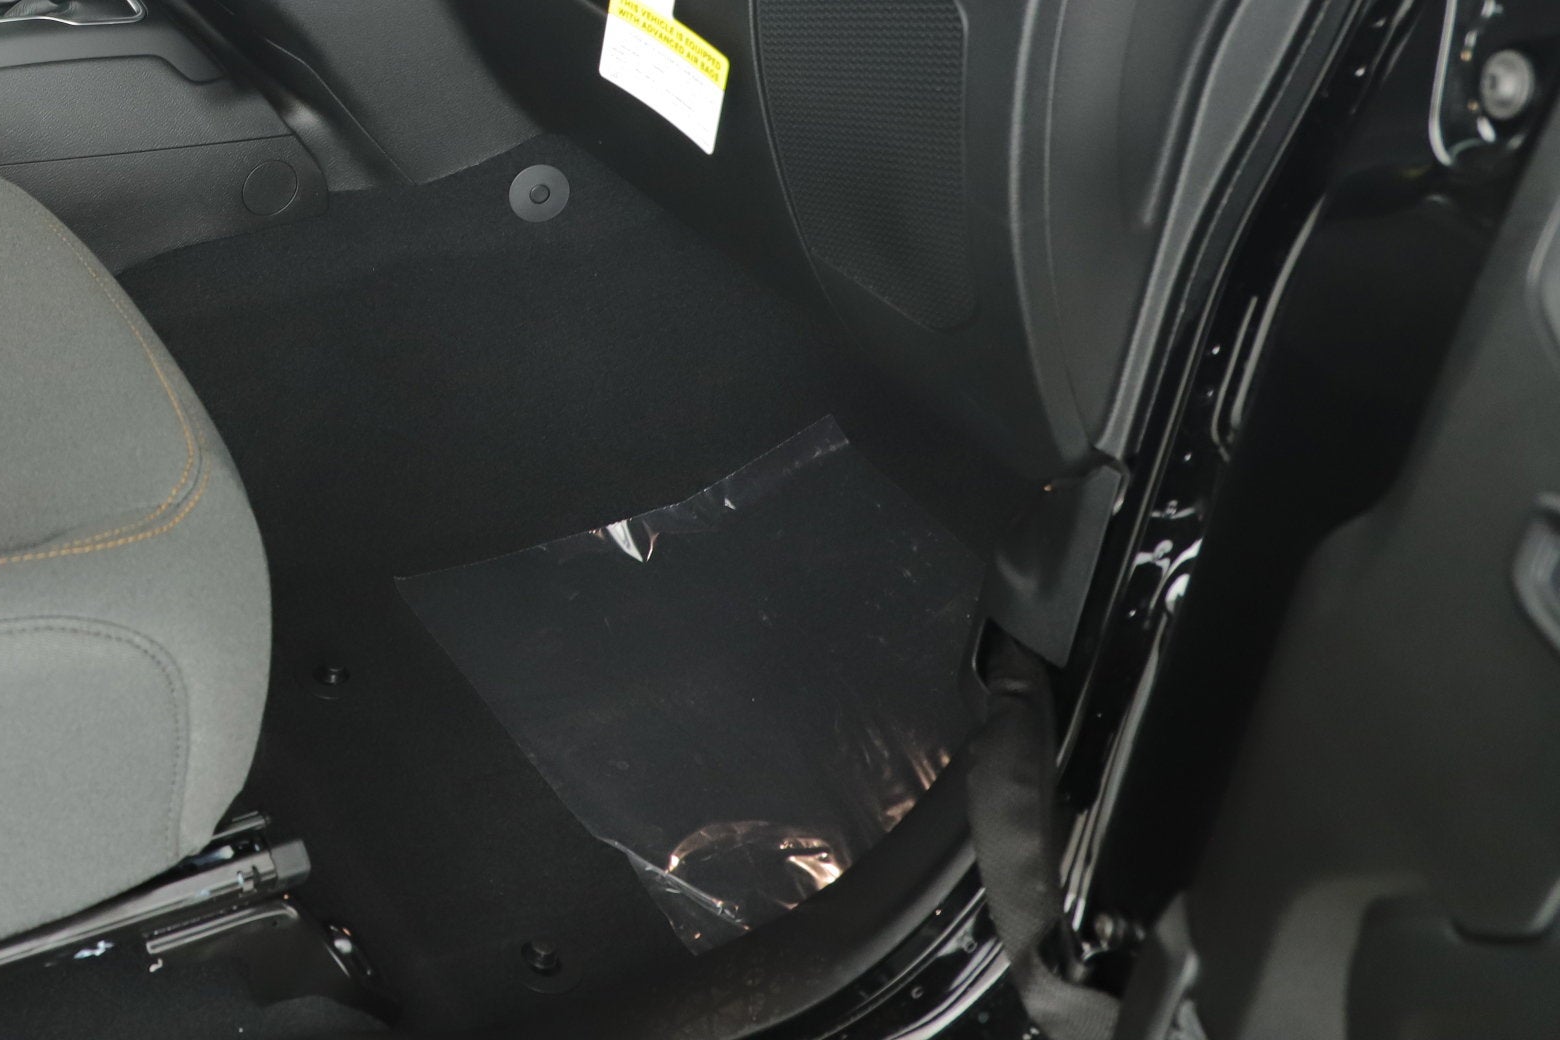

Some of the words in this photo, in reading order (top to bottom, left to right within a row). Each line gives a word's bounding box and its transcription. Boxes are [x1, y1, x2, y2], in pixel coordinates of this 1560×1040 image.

[618, 7, 640, 25] WITH
[641, 21, 685, 55] ADVANCED
[686, 51, 699, 65] AIR
[700, 61, 719, 83] BAGS
[641, 7, 675, 34] VEHICLE
[675, 30, 684, 42] IS
[685, 37, 721, 71] EQUIPPED
